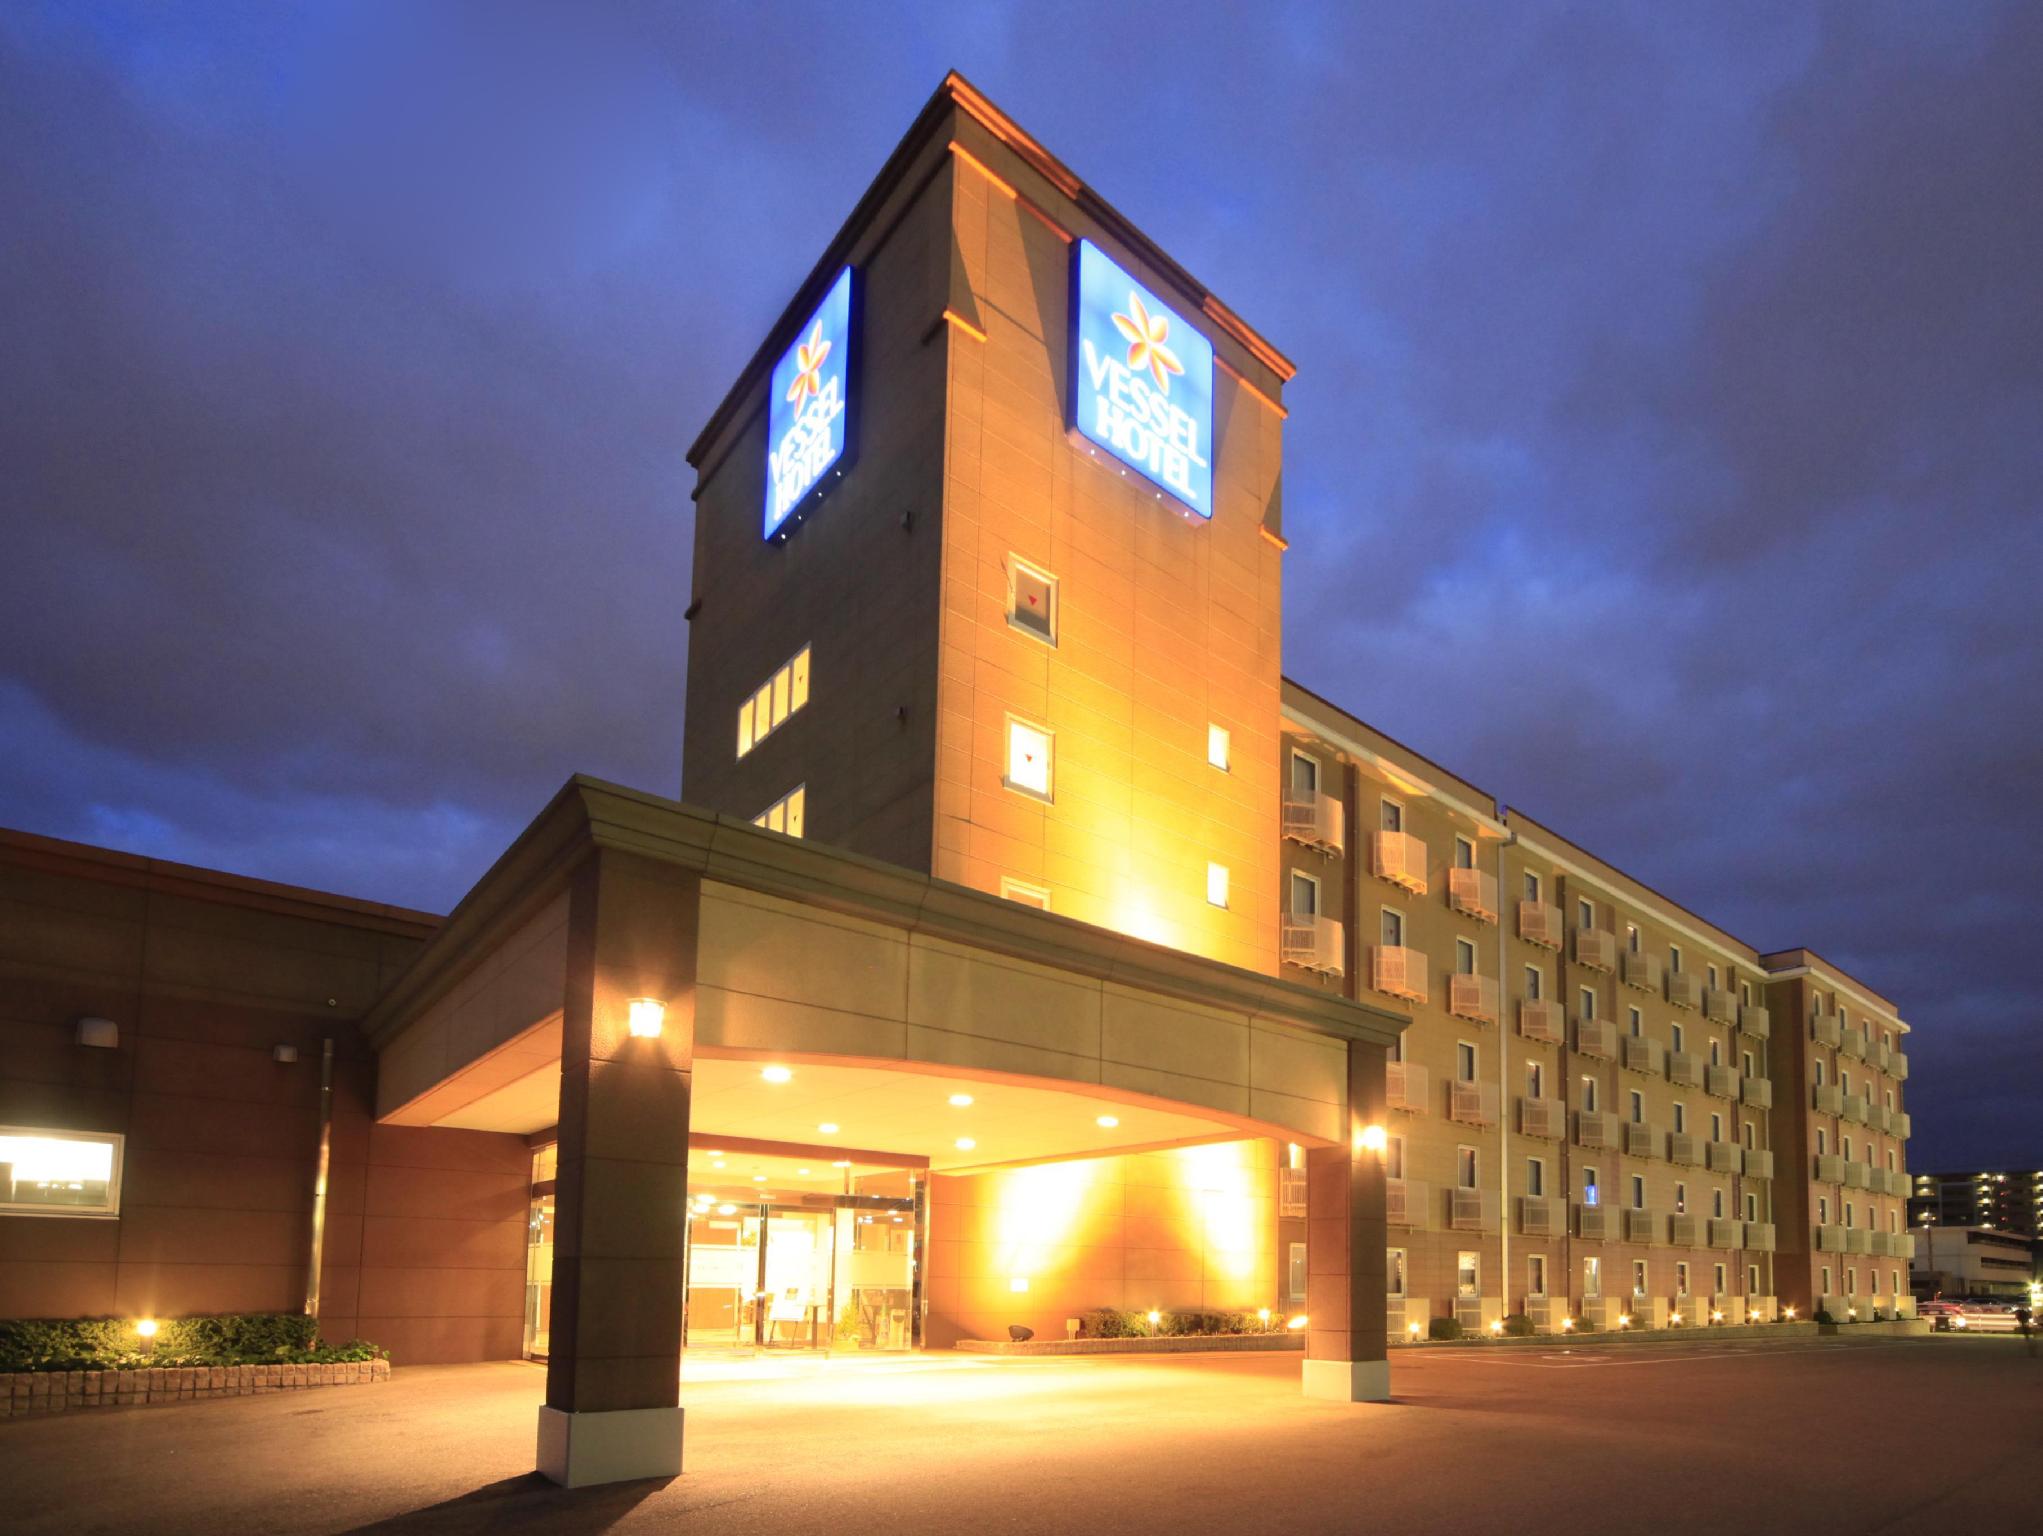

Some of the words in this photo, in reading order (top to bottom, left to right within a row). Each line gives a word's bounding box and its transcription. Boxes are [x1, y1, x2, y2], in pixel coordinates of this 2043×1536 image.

[770, 375, 844, 483] VESSEL
[1083, 339, 1207, 468] VESSEL
[1095, 394, 1197, 499] HOTEL
[774, 427, 836, 521] HOTEL
